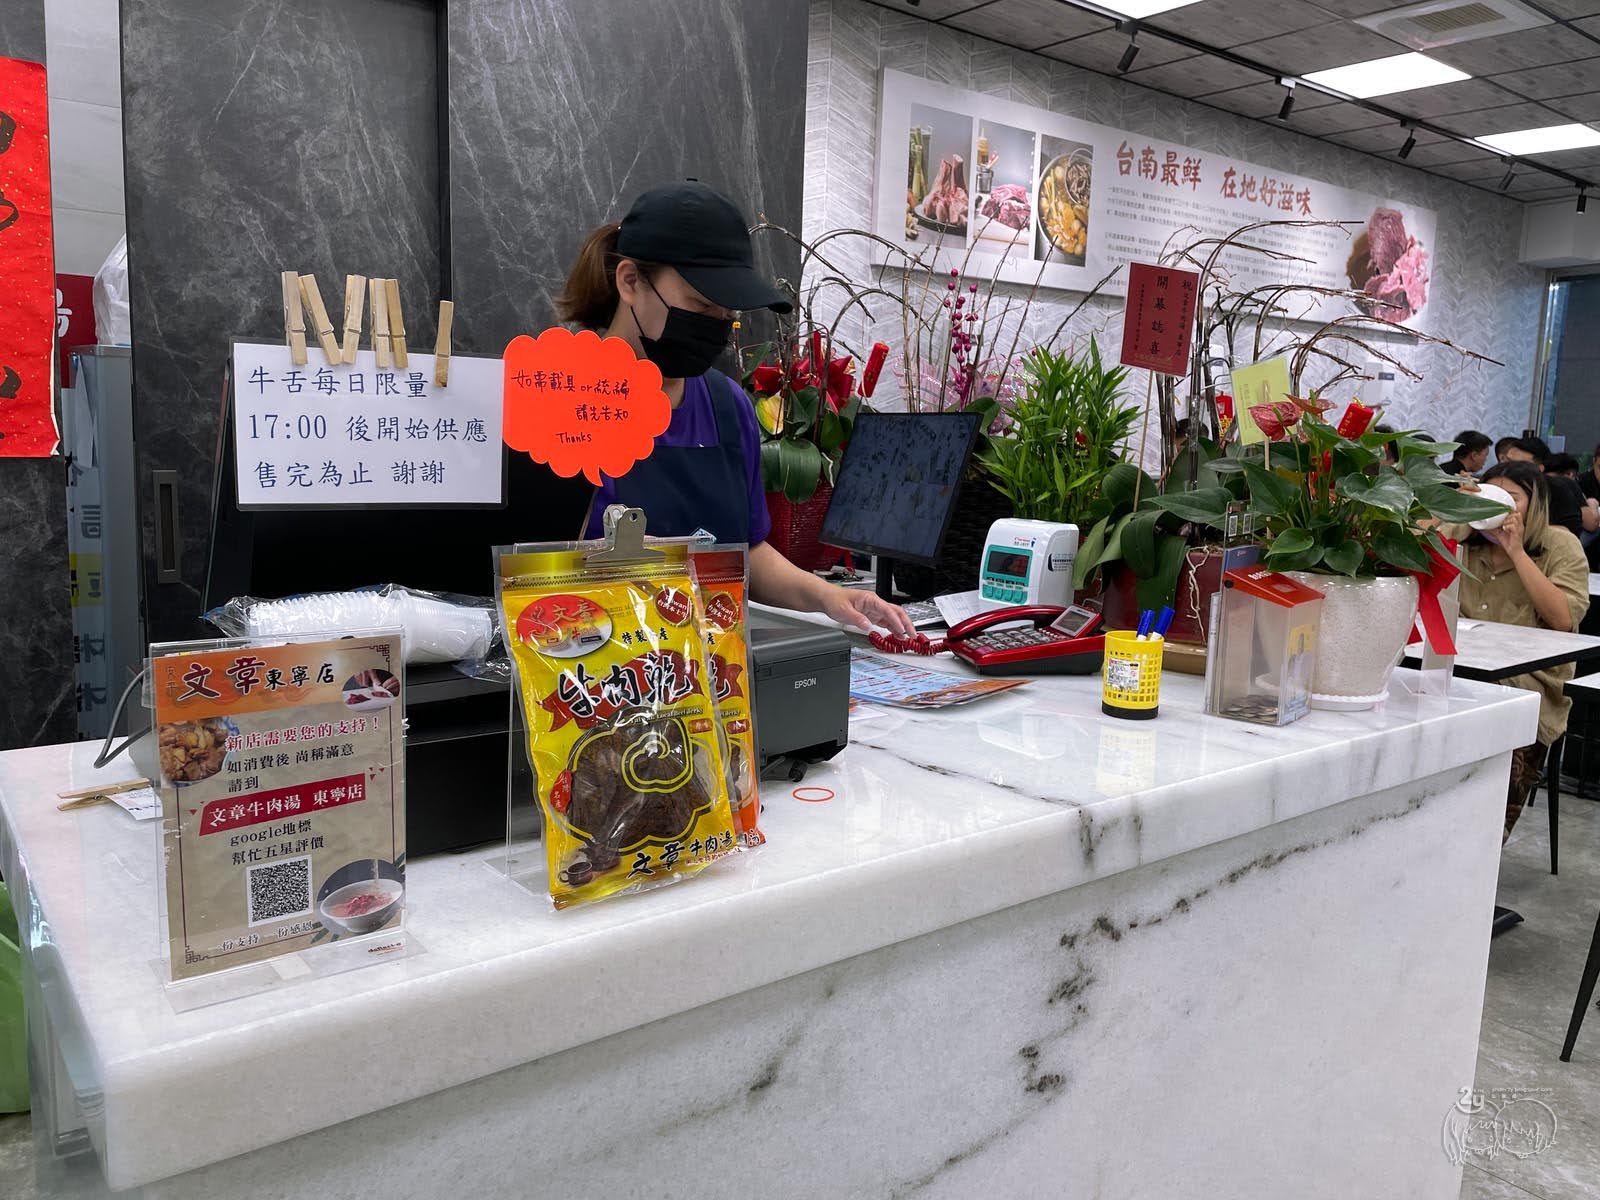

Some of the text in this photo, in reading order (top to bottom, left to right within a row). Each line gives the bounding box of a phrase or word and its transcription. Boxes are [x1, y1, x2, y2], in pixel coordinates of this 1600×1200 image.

[1116, 140, 1313, 216] 台南最鮮 在地好滋味
[248, 365, 429, 399] 牛舌每日限量
[511, 370, 576, 393] 如需載具
[580, 384, 592, 392] or
[575, 404, 629, 421] 請先告知
[249, 414, 488, 443] 17:00 後開始供應
[556, 432, 592, 443] Thanks
[254, 460, 446, 488] 售完為止 謝謝
[794, 677, 817, 689] EPSON
[227, 743, 355, 775] 如消費後 尚稱滿意
[228, 776, 259, 793] 請到
[209, 783, 364, 827] 文章牛肉湯 東寧店
[230, 818, 312, 847] google地標
[232, 835, 325, 866] 幫忙五星評價
[626, 830, 733, 879] 文章牛肉湯
